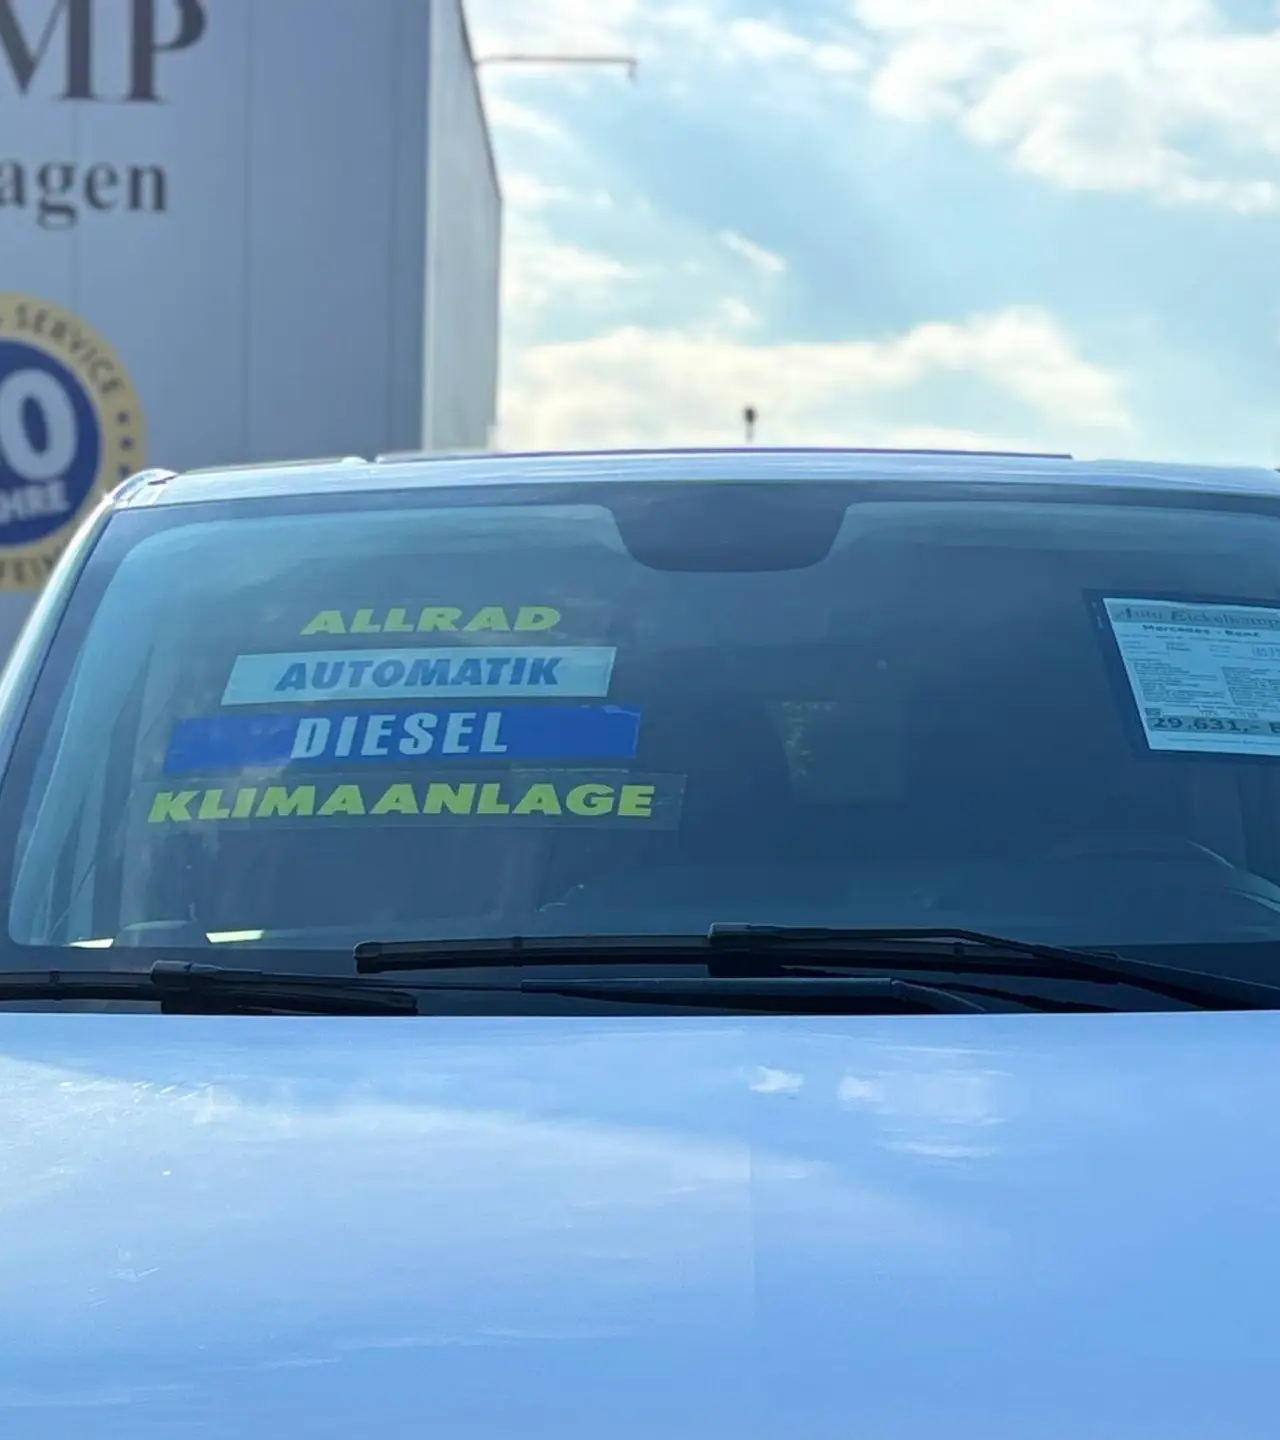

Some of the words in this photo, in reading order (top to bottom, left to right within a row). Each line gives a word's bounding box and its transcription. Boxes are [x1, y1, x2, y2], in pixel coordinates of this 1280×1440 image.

[14, 301, 127, 396] SERVICE
[300, 606, 561, 635] ALLRAD
[273, 657, 563, 692] AUTOMATIK
[290, 711, 508, 759] DIESEL
[147, 782, 655, 823] KLIMAANLAGE
